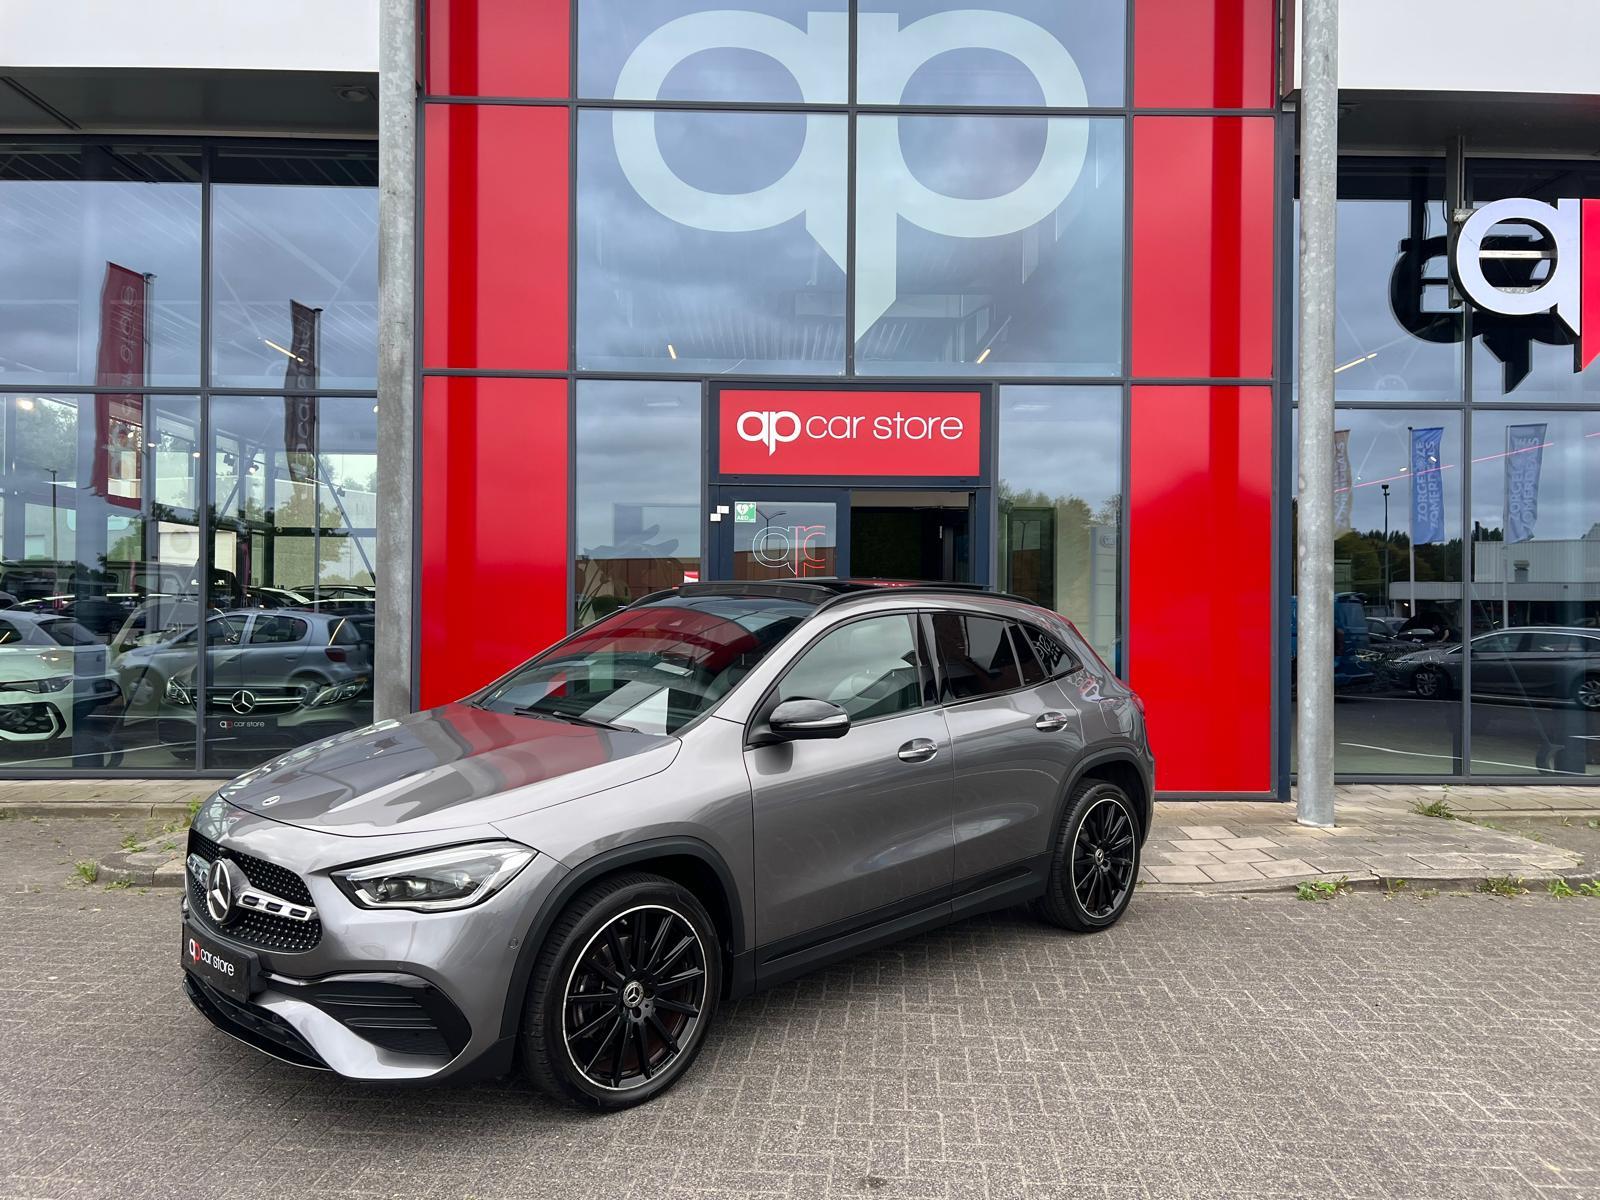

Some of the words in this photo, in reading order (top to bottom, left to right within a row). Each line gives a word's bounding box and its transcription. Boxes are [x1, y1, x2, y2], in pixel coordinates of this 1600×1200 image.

[612, 9, 1090, 343] ap
[1457, 197, 1600, 374] a
[736, 410, 802, 457] ap
[805, 415, 866, 439] car
[872, 411, 964, 440] store
[246, 720, 265, 728] store
[189, 938, 201, 965] ap
[200, 948, 213, 965] car
[212, 955, 235, 977] store
